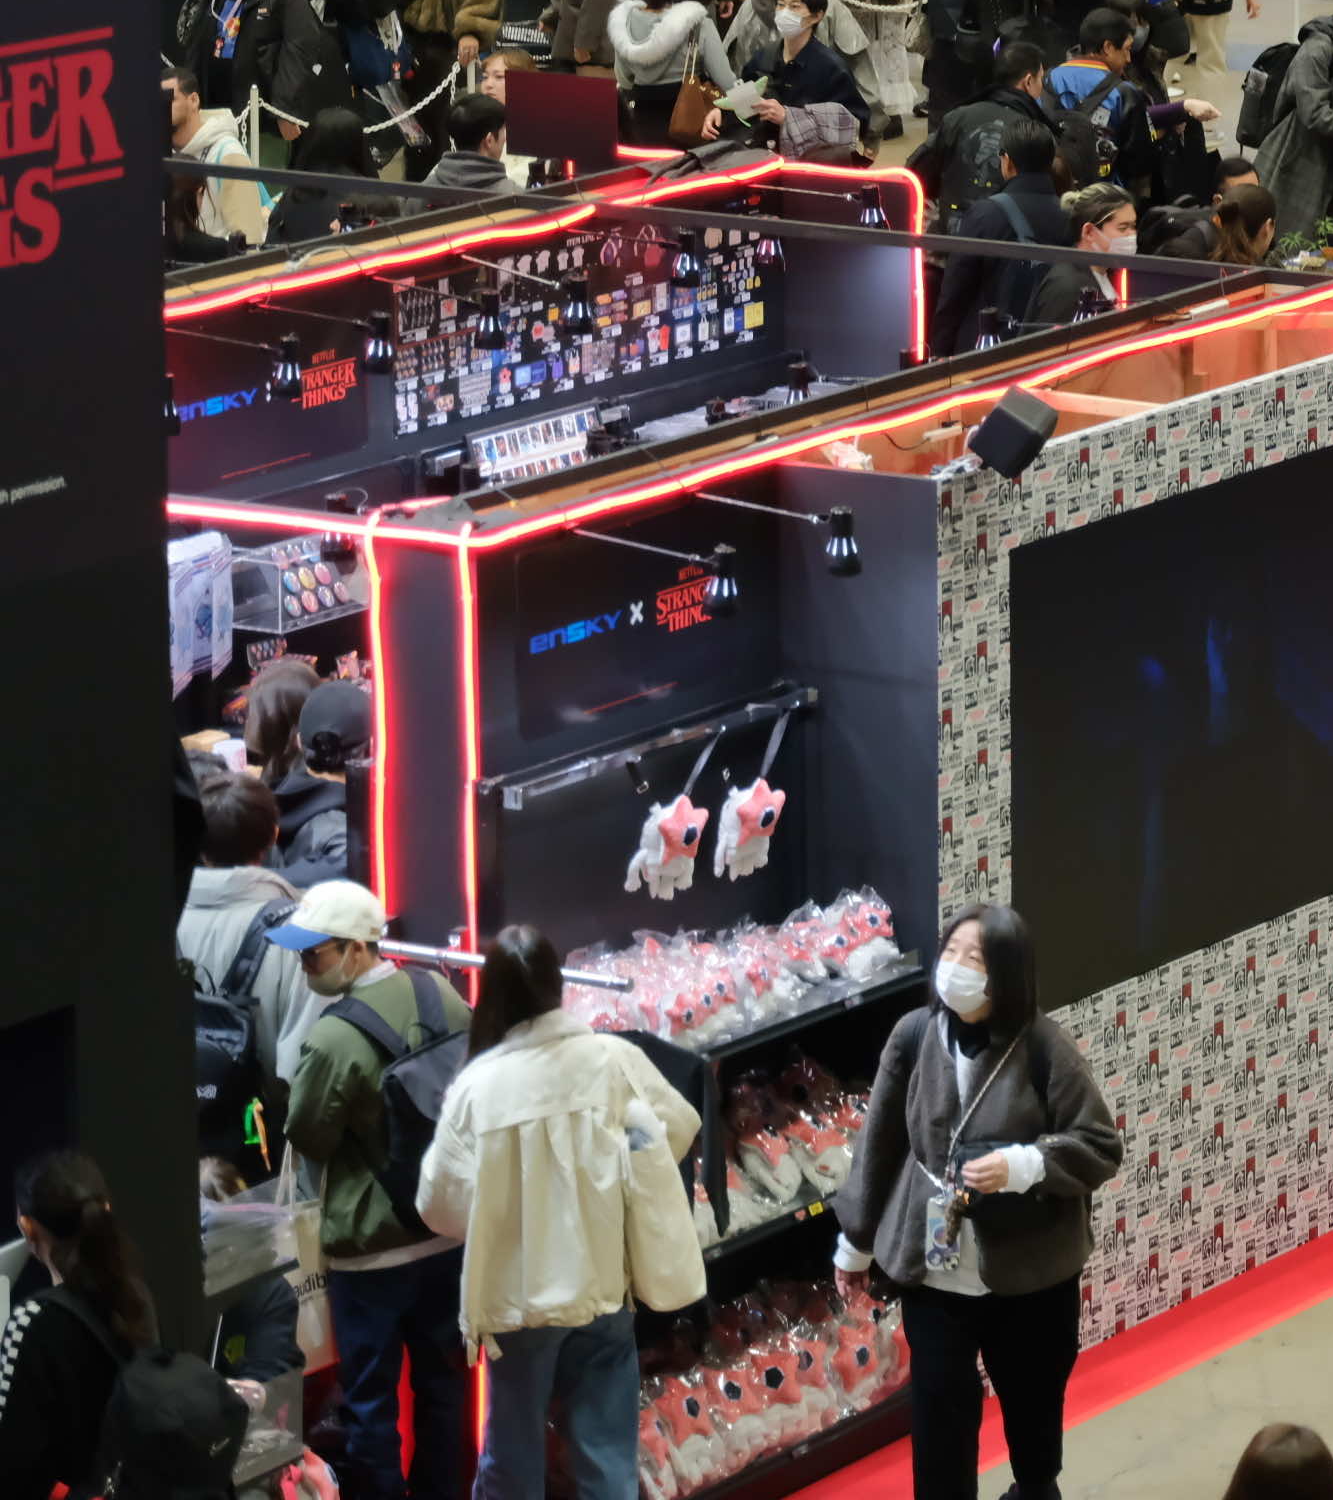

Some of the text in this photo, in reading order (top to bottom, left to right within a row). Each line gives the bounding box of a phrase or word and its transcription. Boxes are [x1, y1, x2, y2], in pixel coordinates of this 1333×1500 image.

[0, 48, 124, 171] ER
[300, 361, 356, 391] TRANGER
[301, 381, 347, 411] THINGS
[656, 580, 706, 621] STRANG
[293, 1270, 328, 1298] audib
